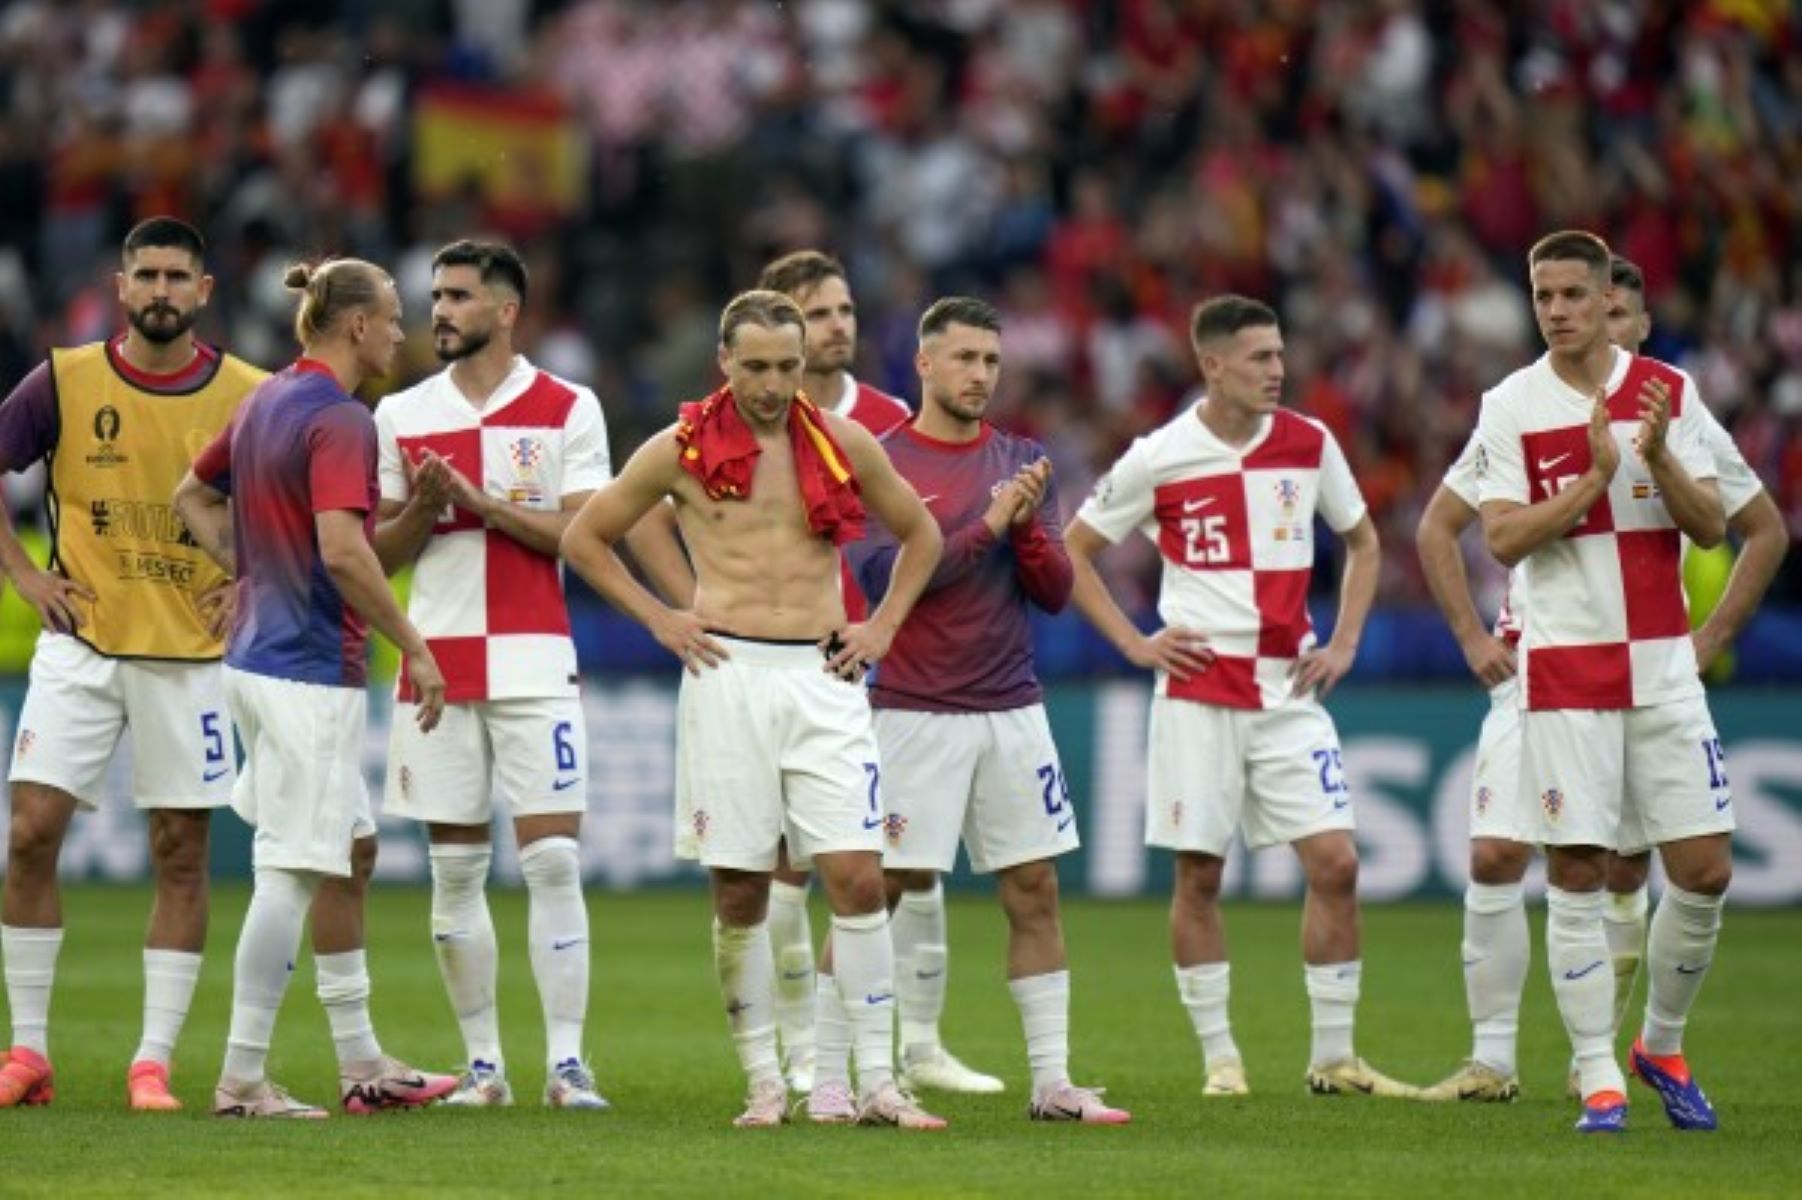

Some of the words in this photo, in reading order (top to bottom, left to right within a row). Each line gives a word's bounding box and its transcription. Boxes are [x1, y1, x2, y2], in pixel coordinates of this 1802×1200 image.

[1180, 516, 1230, 562] 25
[201, 712, 224, 762] 5
[552, 721, 576, 769] 6
[862, 762, 880, 812] 7
